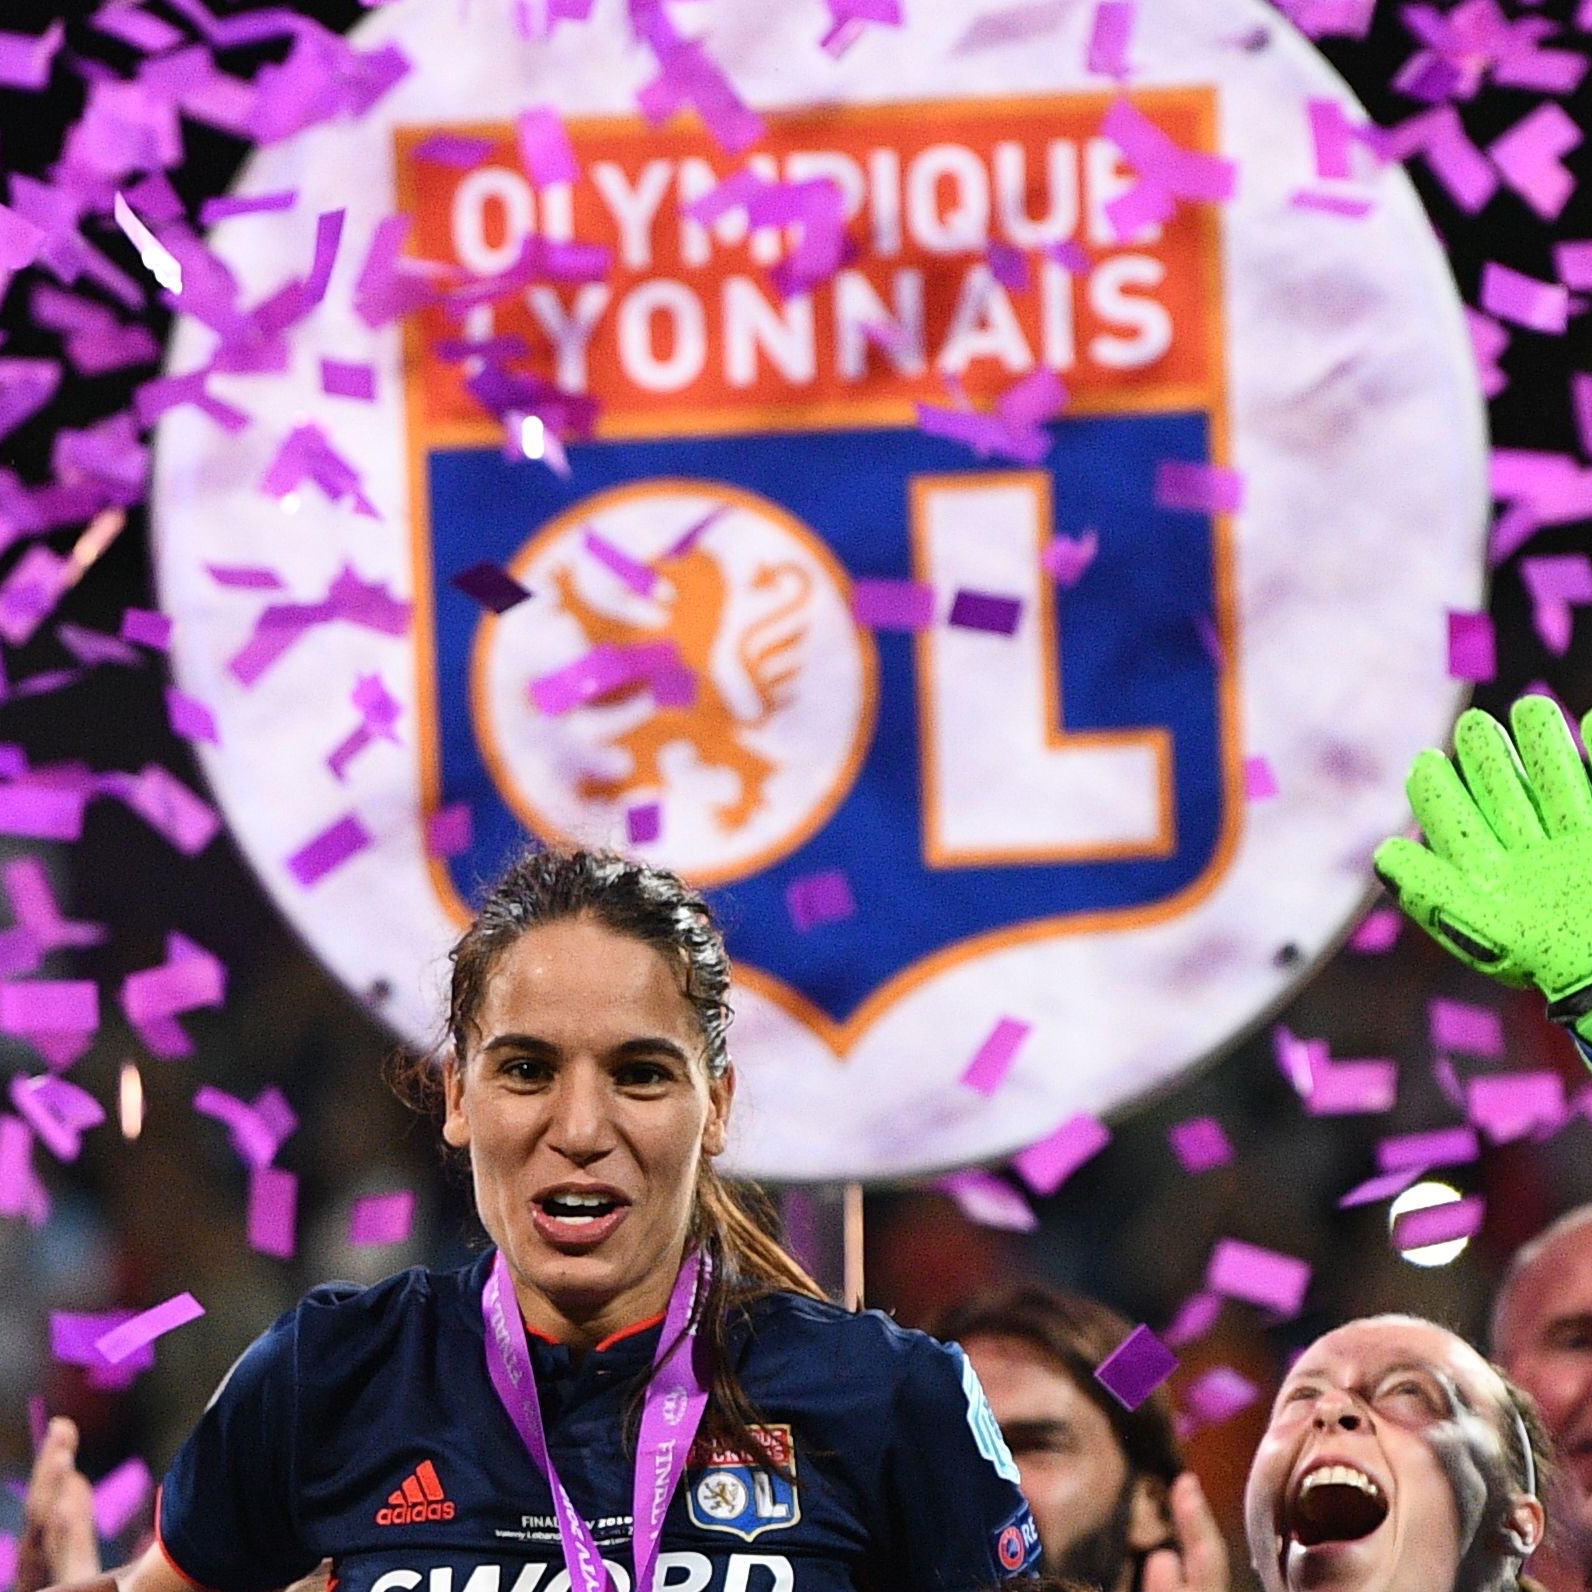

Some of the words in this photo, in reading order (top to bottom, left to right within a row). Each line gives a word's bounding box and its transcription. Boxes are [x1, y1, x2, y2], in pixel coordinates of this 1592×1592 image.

[462, 255, 1174, 396] YONNAIS
[470, 468, 1174, 887] OL
[375, 1501, 456, 1526] adidas
[697, 1471, 791, 1520] OL
